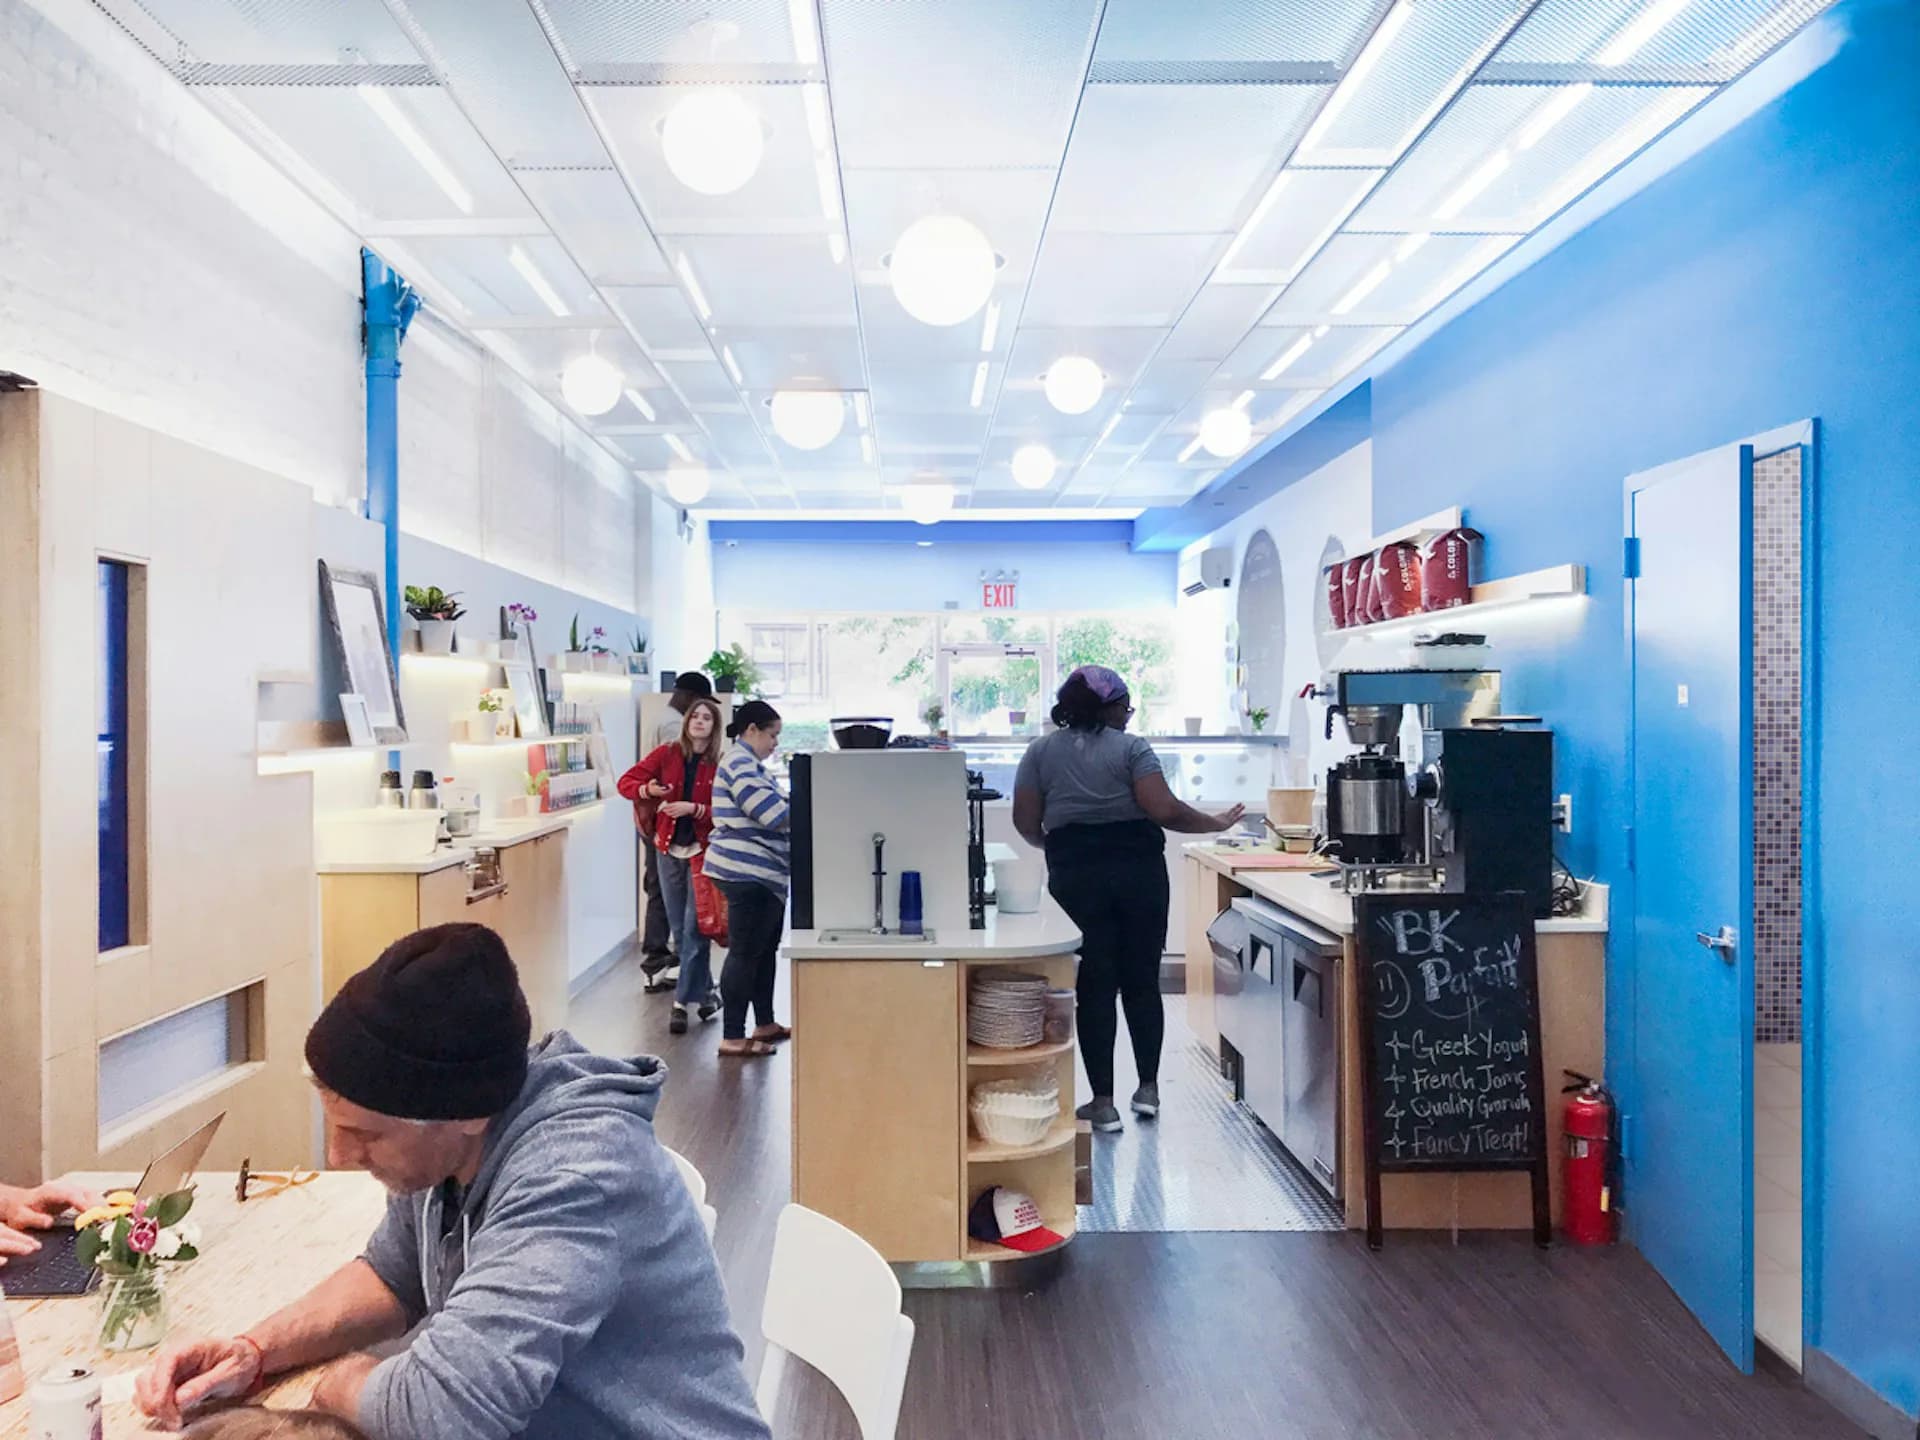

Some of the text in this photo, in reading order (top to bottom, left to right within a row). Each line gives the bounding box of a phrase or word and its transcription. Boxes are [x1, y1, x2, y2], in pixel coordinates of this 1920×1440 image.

[983, 584, 1016, 607] EXIT
[1412, 1029, 1478, 1065] Greek
[1411, 1063, 1527, 1094] French Jams
[1410, 1093, 1474, 1125] Quality
[1411, 1122, 1529, 1157] Fancy Treat!
